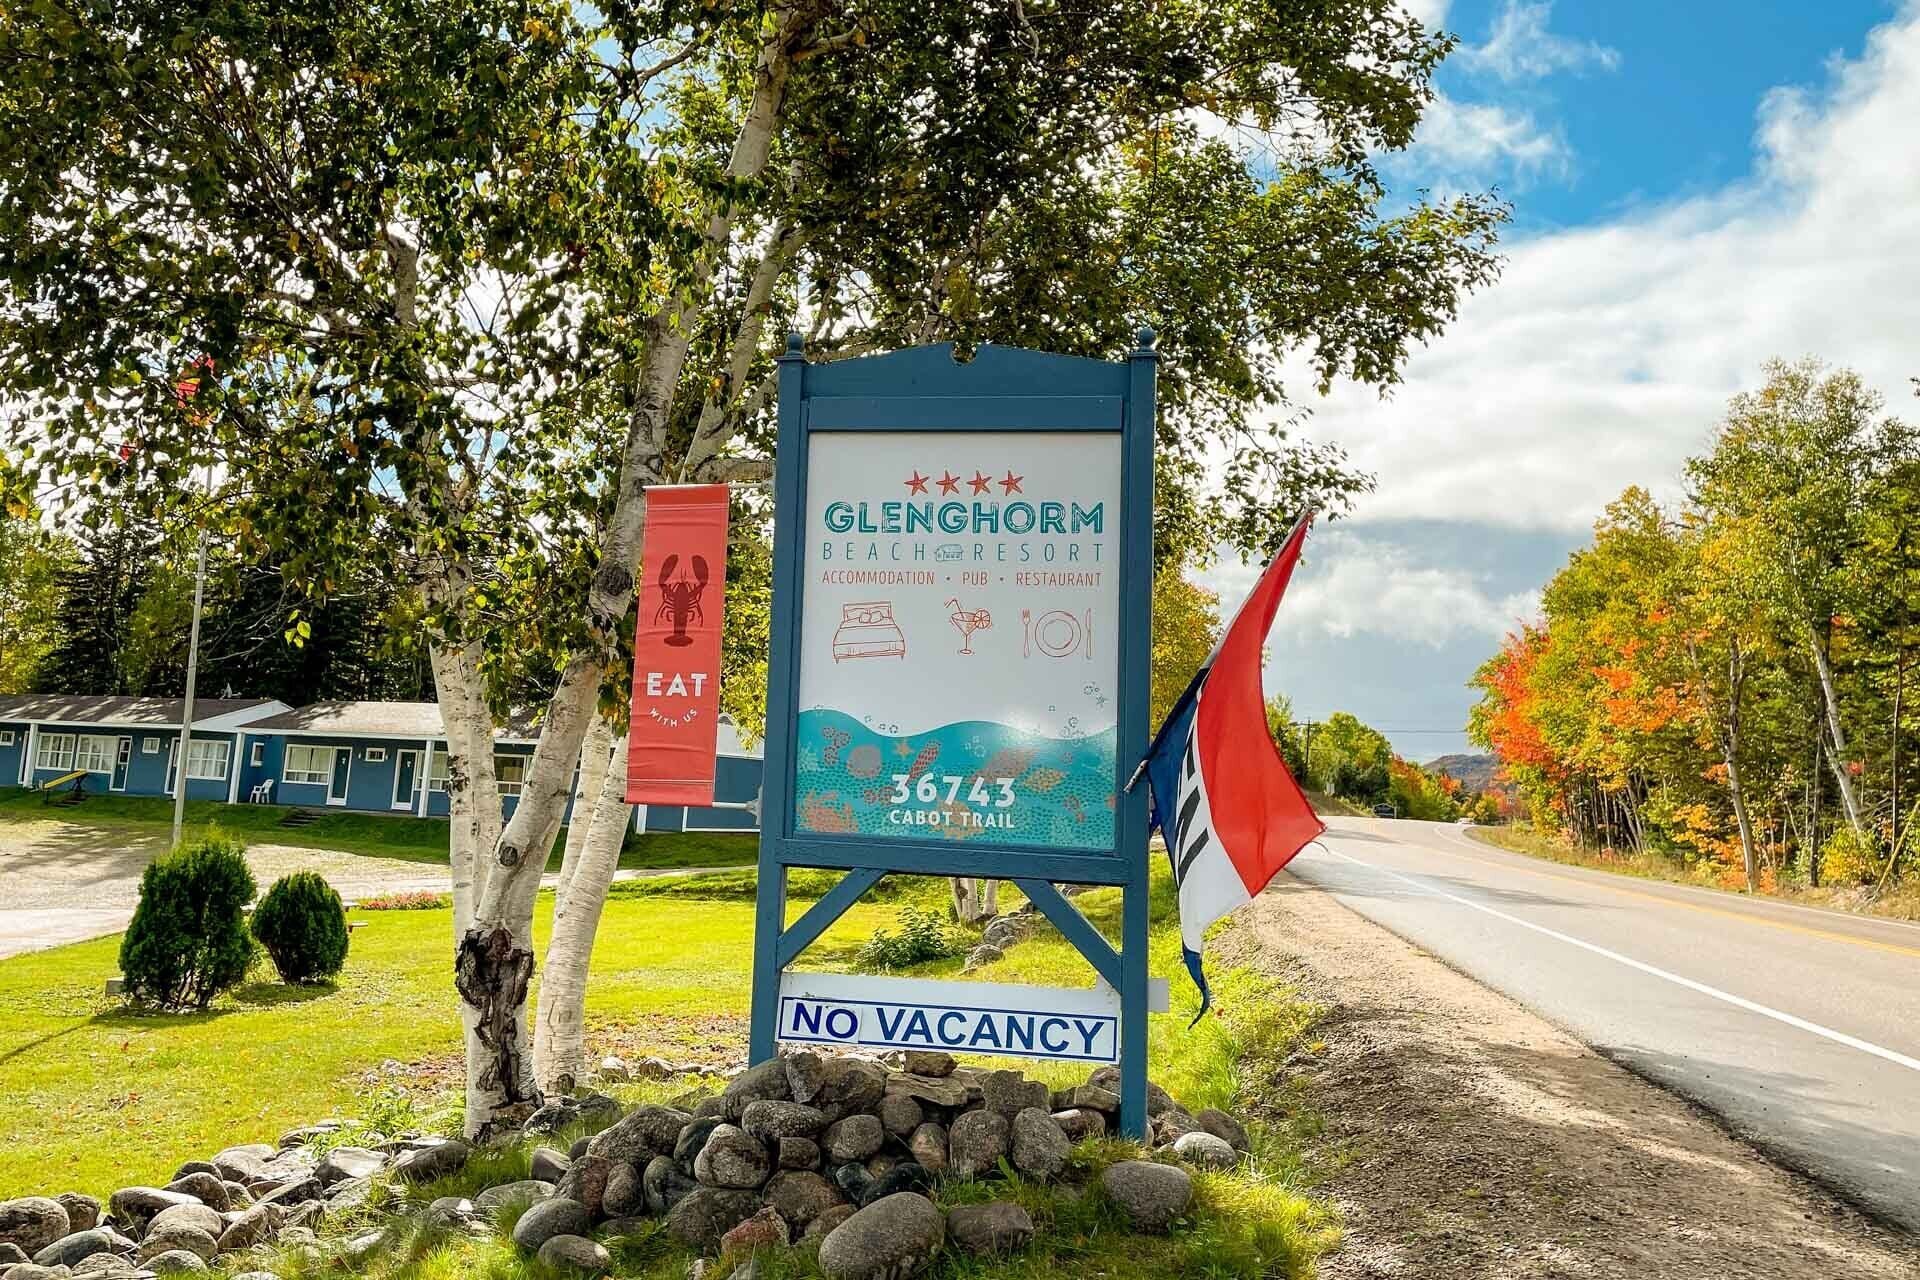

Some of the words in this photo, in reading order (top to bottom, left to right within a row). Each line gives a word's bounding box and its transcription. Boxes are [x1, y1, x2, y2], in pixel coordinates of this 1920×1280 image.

[824, 501, 1103, 534] GLENGHORM
[822, 542, 926, 561] BEACH
[973, 543, 1104, 562] RESORT
[821, 570, 935, 586] ACCOMMODATION
[962, 571, 988, 586] PUB
[1015, 571, 1102, 587] RESTAURANT
[647, 672, 707, 697] EAT
[649, 707, 678, 727] WITH
[683, 708, 698, 722] US
[890, 773, 1016, 808] 36743
[889, 809, 952, 826] CABOT
[960, 811, 1015, 829] TRAIL
[792, 1003, 859, 1039] NO
[877, 1007, 1105, 1054] VACANCY
